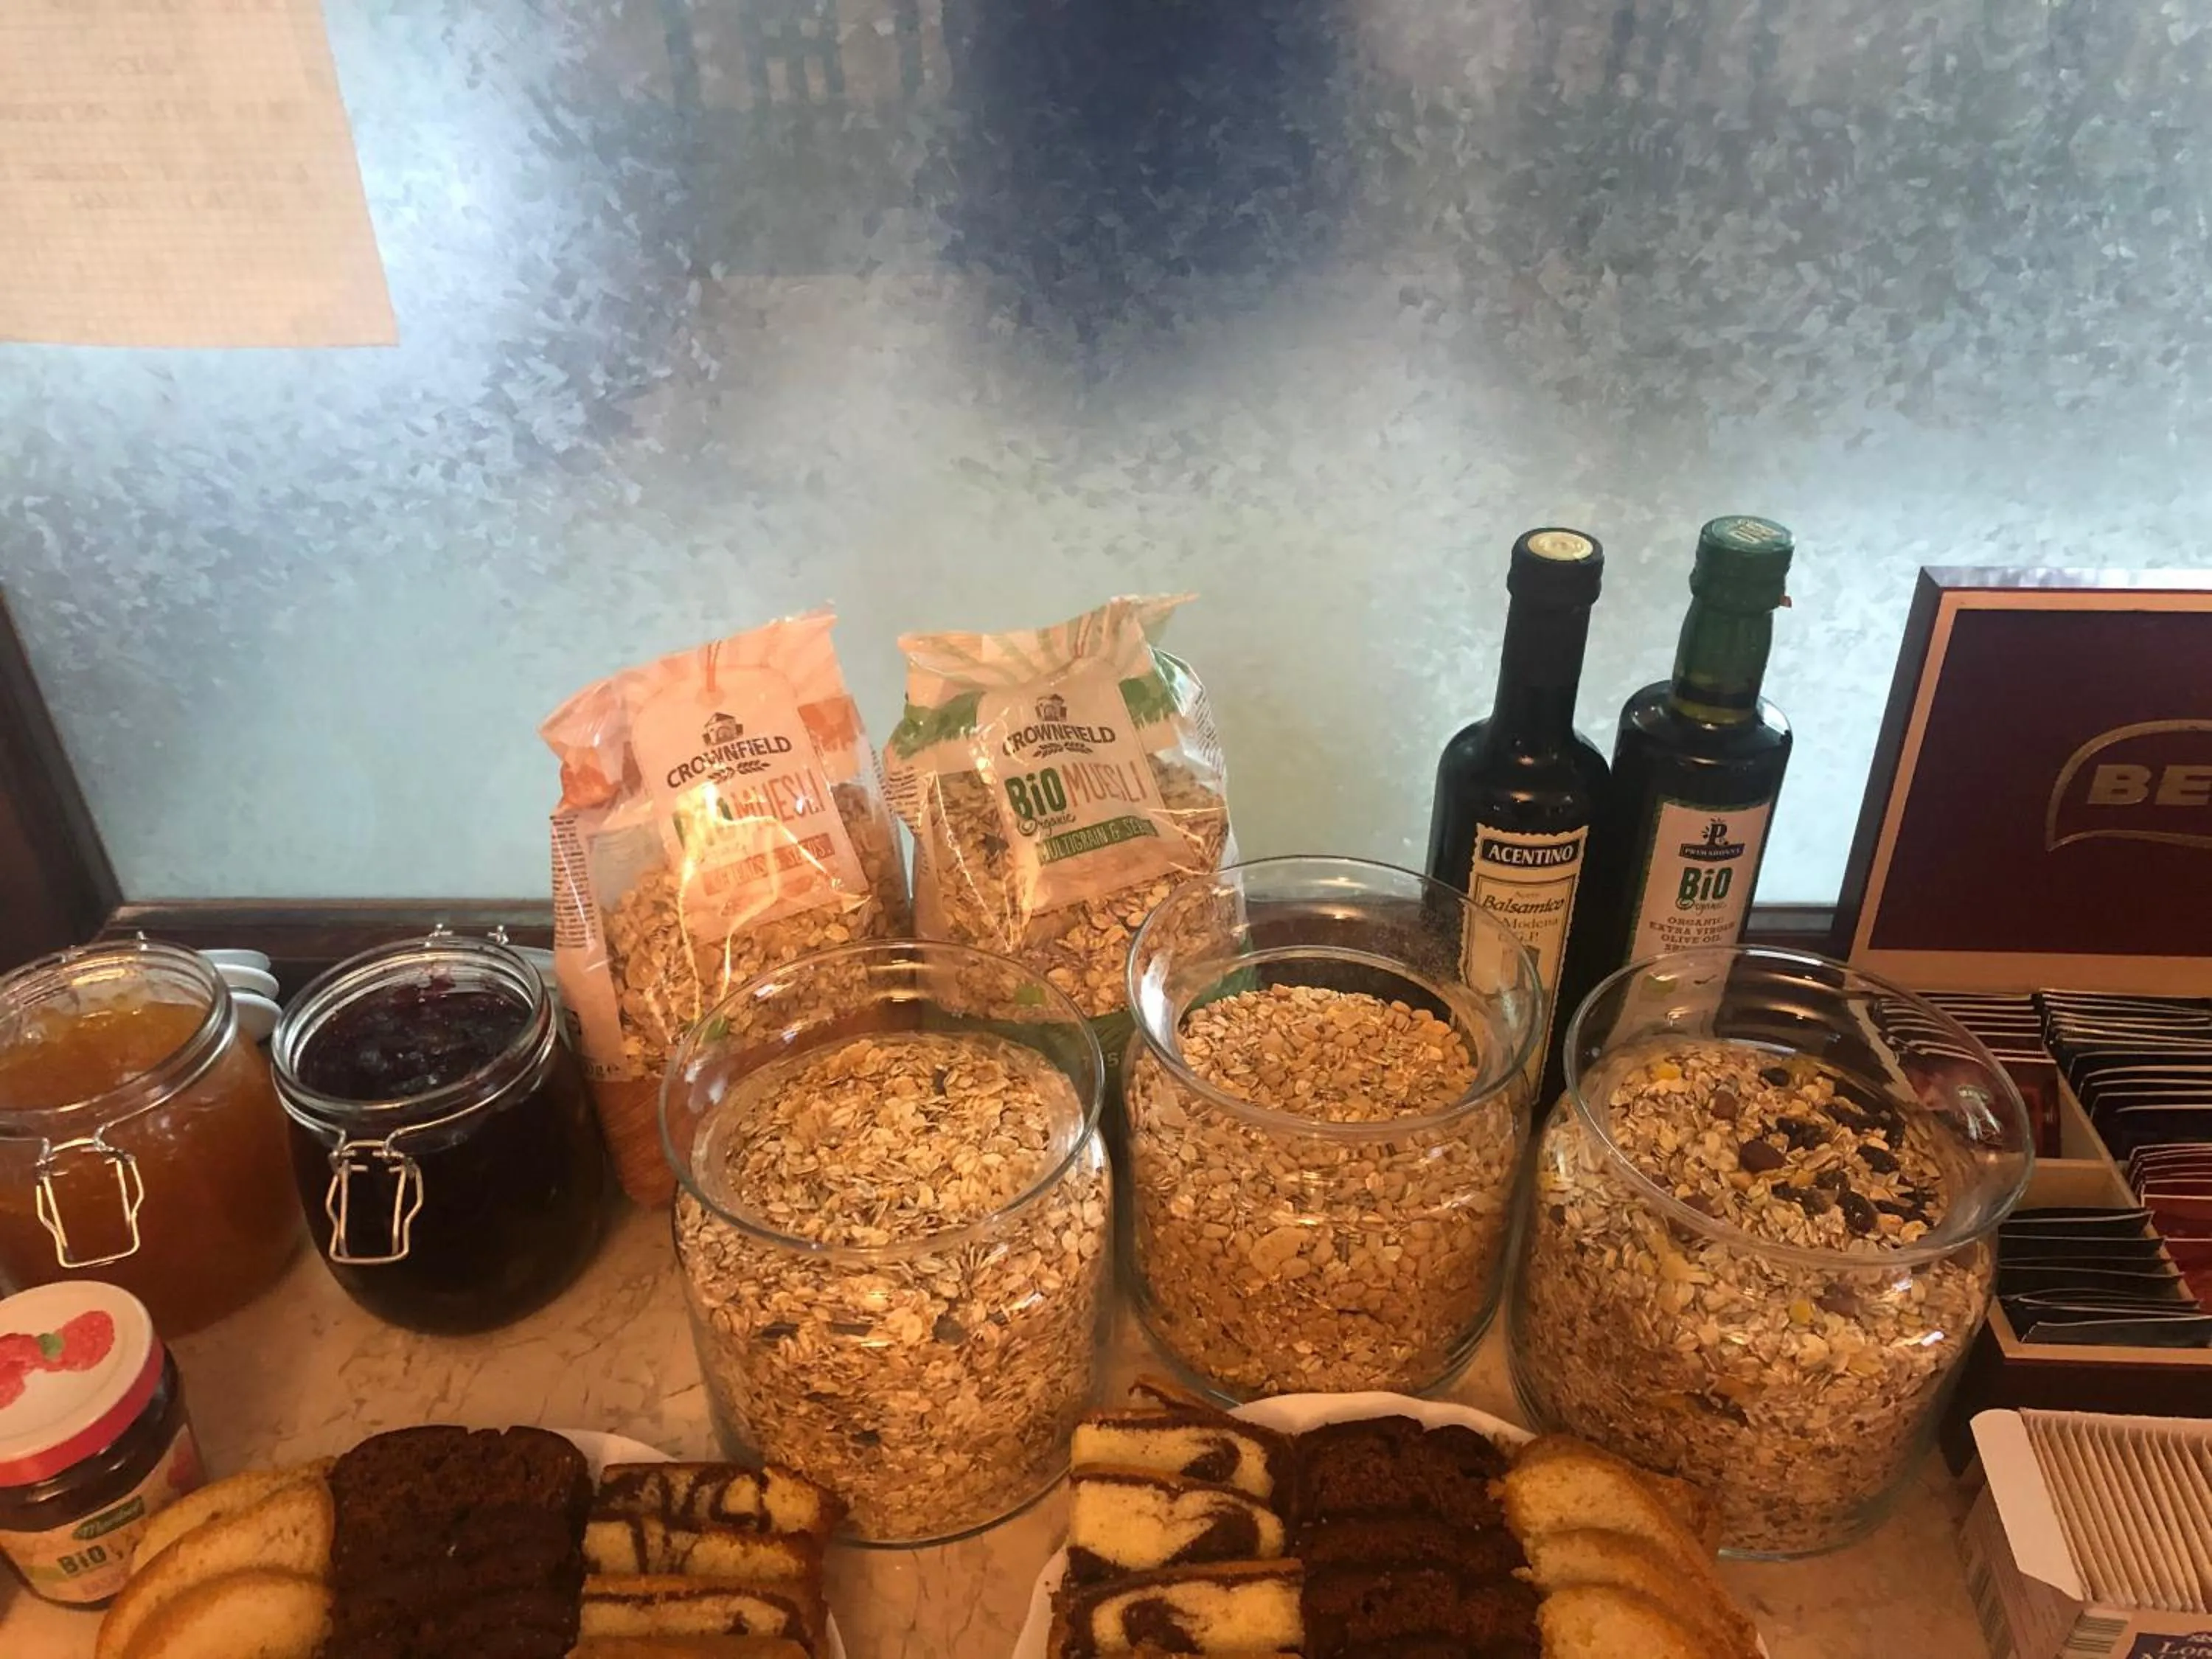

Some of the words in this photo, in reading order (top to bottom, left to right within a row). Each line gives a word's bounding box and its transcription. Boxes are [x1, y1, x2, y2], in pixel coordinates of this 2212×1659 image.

[1003, 723, 1116, 756] CROWNFIELD
[667, 736, 792, 788] CROWNFIELD
[1062, 760, 1147, 807] MUESLI
[1489, 844, 1573, 864] ACENTINO
[1482, 894, 1565, 914] Balsamico
[1649, 921, 1692, 936] EXTRA
[1697, 922, 1735, 936] VIRGIN
[1667, 916, 1724, 926] ORGANIC
[1660, 933, 1700, 944] OLIVE
[1703, 933, 1722, 943] OIL
